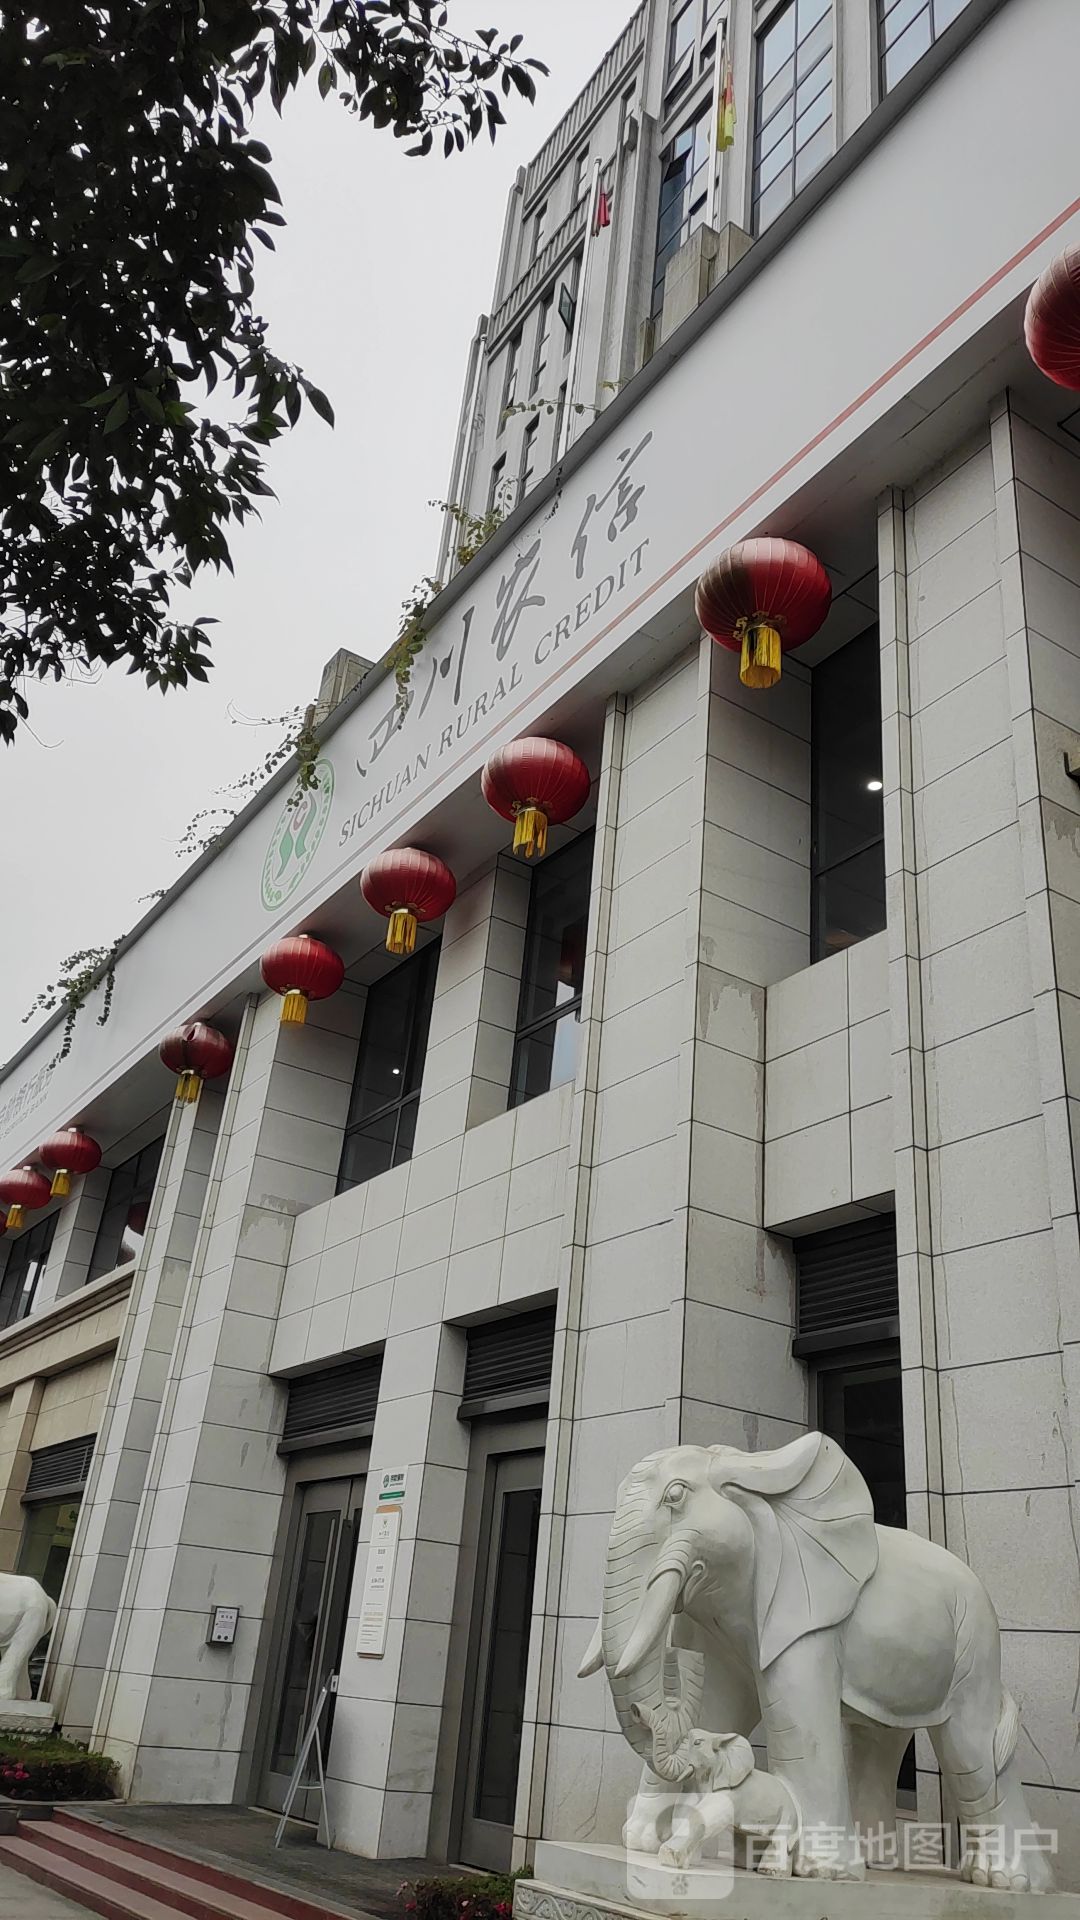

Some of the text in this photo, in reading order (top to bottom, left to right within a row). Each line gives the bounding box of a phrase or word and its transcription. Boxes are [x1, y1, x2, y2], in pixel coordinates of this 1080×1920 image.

[339, 744, 431, 846] SICHUAN
[438, 663, 522, 756] RURAL
[534, 538, 649, 664] CREDIT
[357, 431, 653, 778] 四川农信
